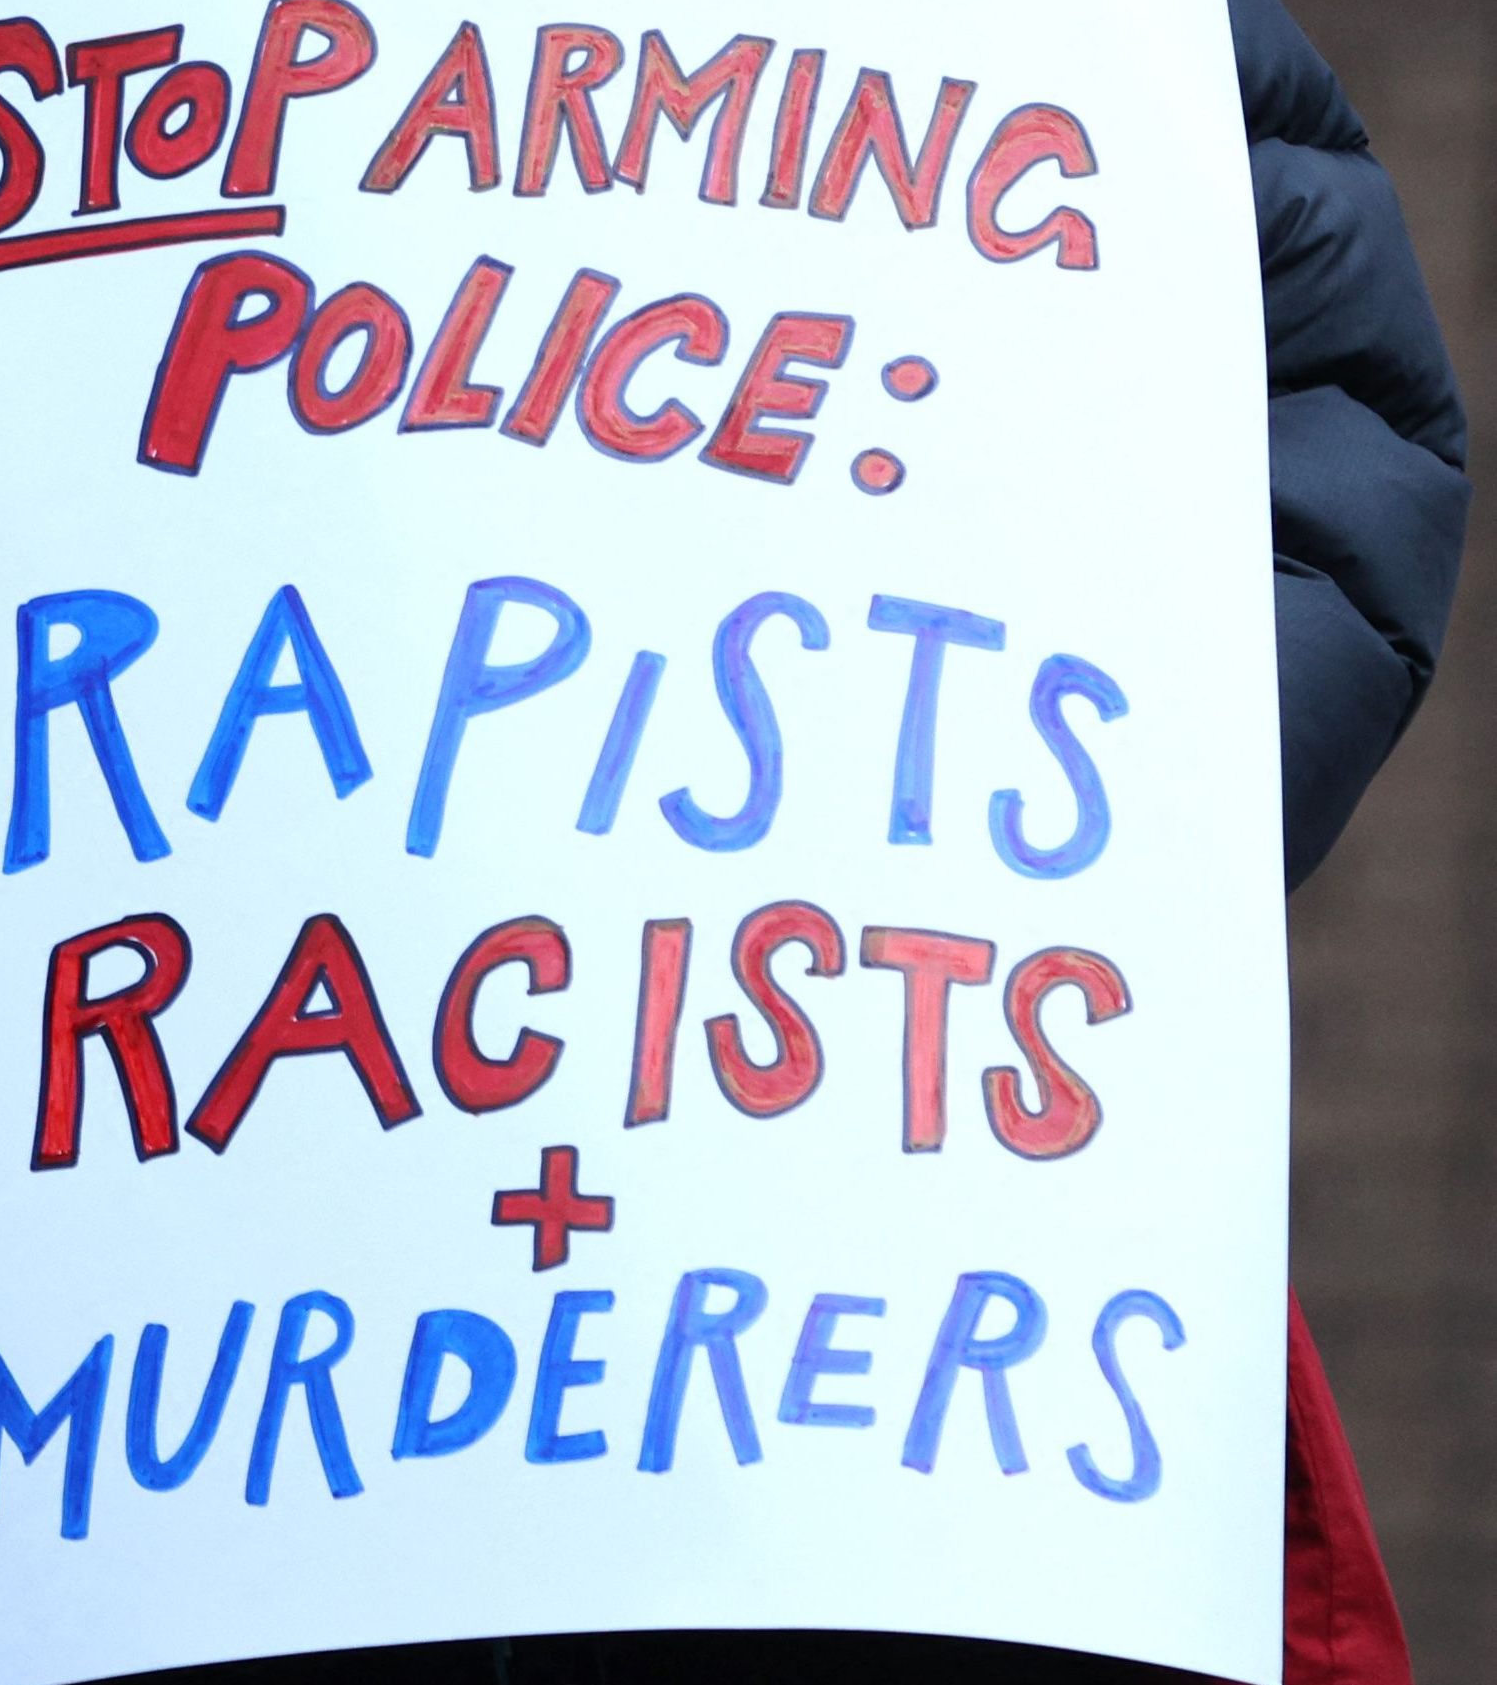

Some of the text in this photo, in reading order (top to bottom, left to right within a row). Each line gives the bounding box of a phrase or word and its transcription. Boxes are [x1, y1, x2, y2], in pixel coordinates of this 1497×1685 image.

[357, 19, 1101, 273] ARMING
[134, 248, 941, 498] POLICE:
[27, 897, 1135, 1176] RACISTS
[489, 1142, 618, 1276] +
